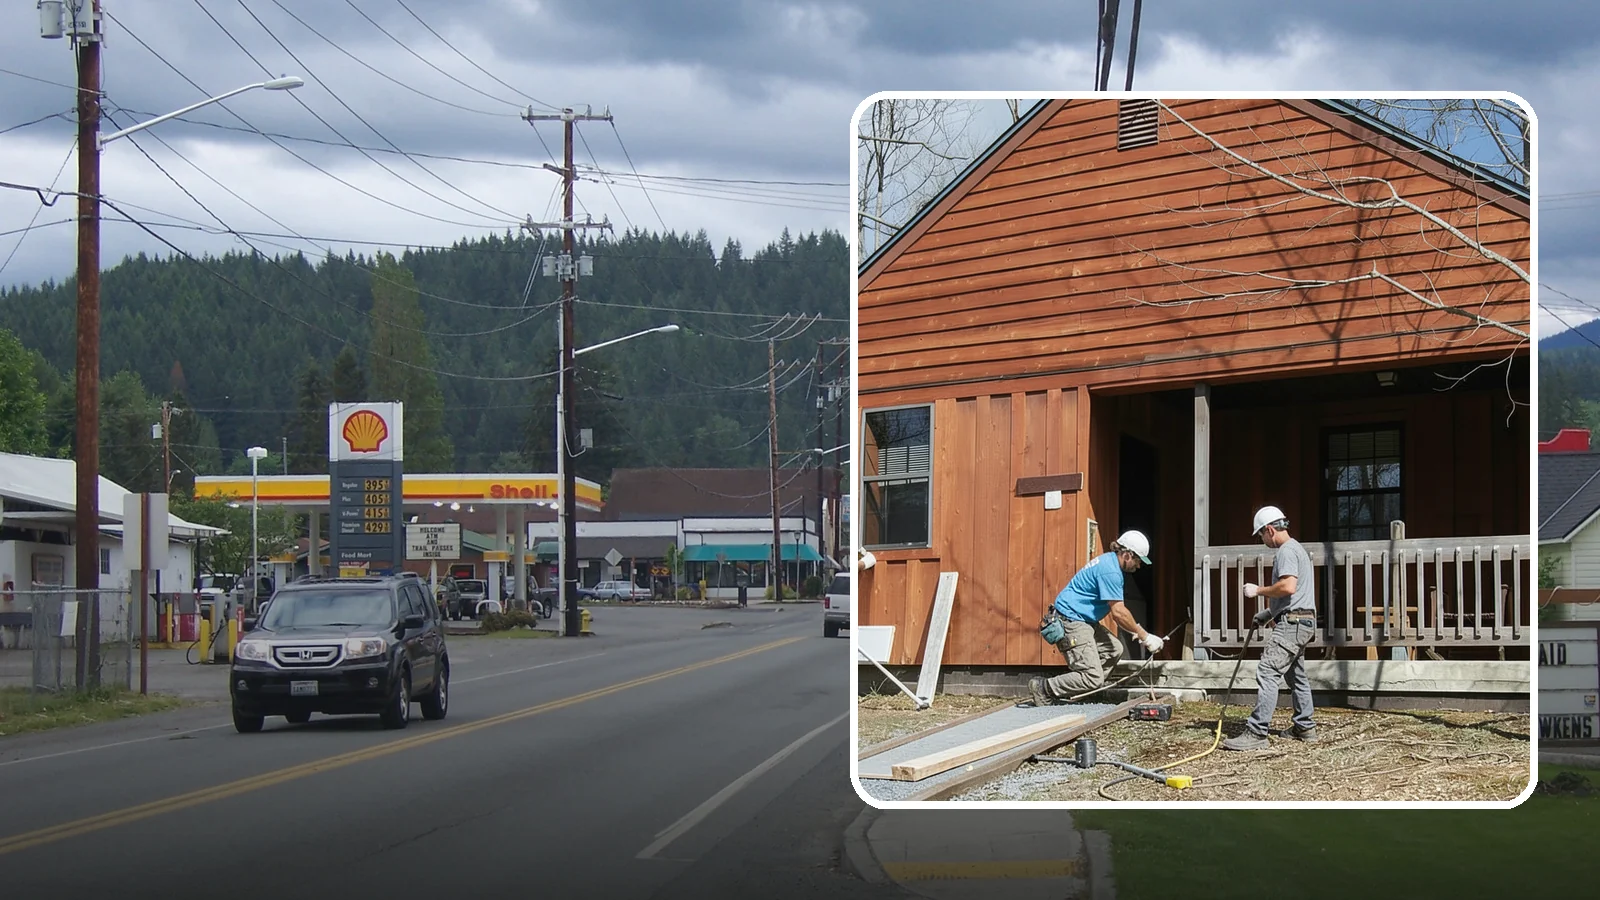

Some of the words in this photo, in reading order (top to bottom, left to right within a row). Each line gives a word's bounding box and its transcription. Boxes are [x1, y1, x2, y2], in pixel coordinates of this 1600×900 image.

[366, 480, 383, 490] 395
[490, 484, 547, 499] Shell
[366, 494, 383, 504] 405
[366, 508, 383, 518] 415
[366, 522, 383, 533] 429
[1538, 642, 1567, 665] AID
